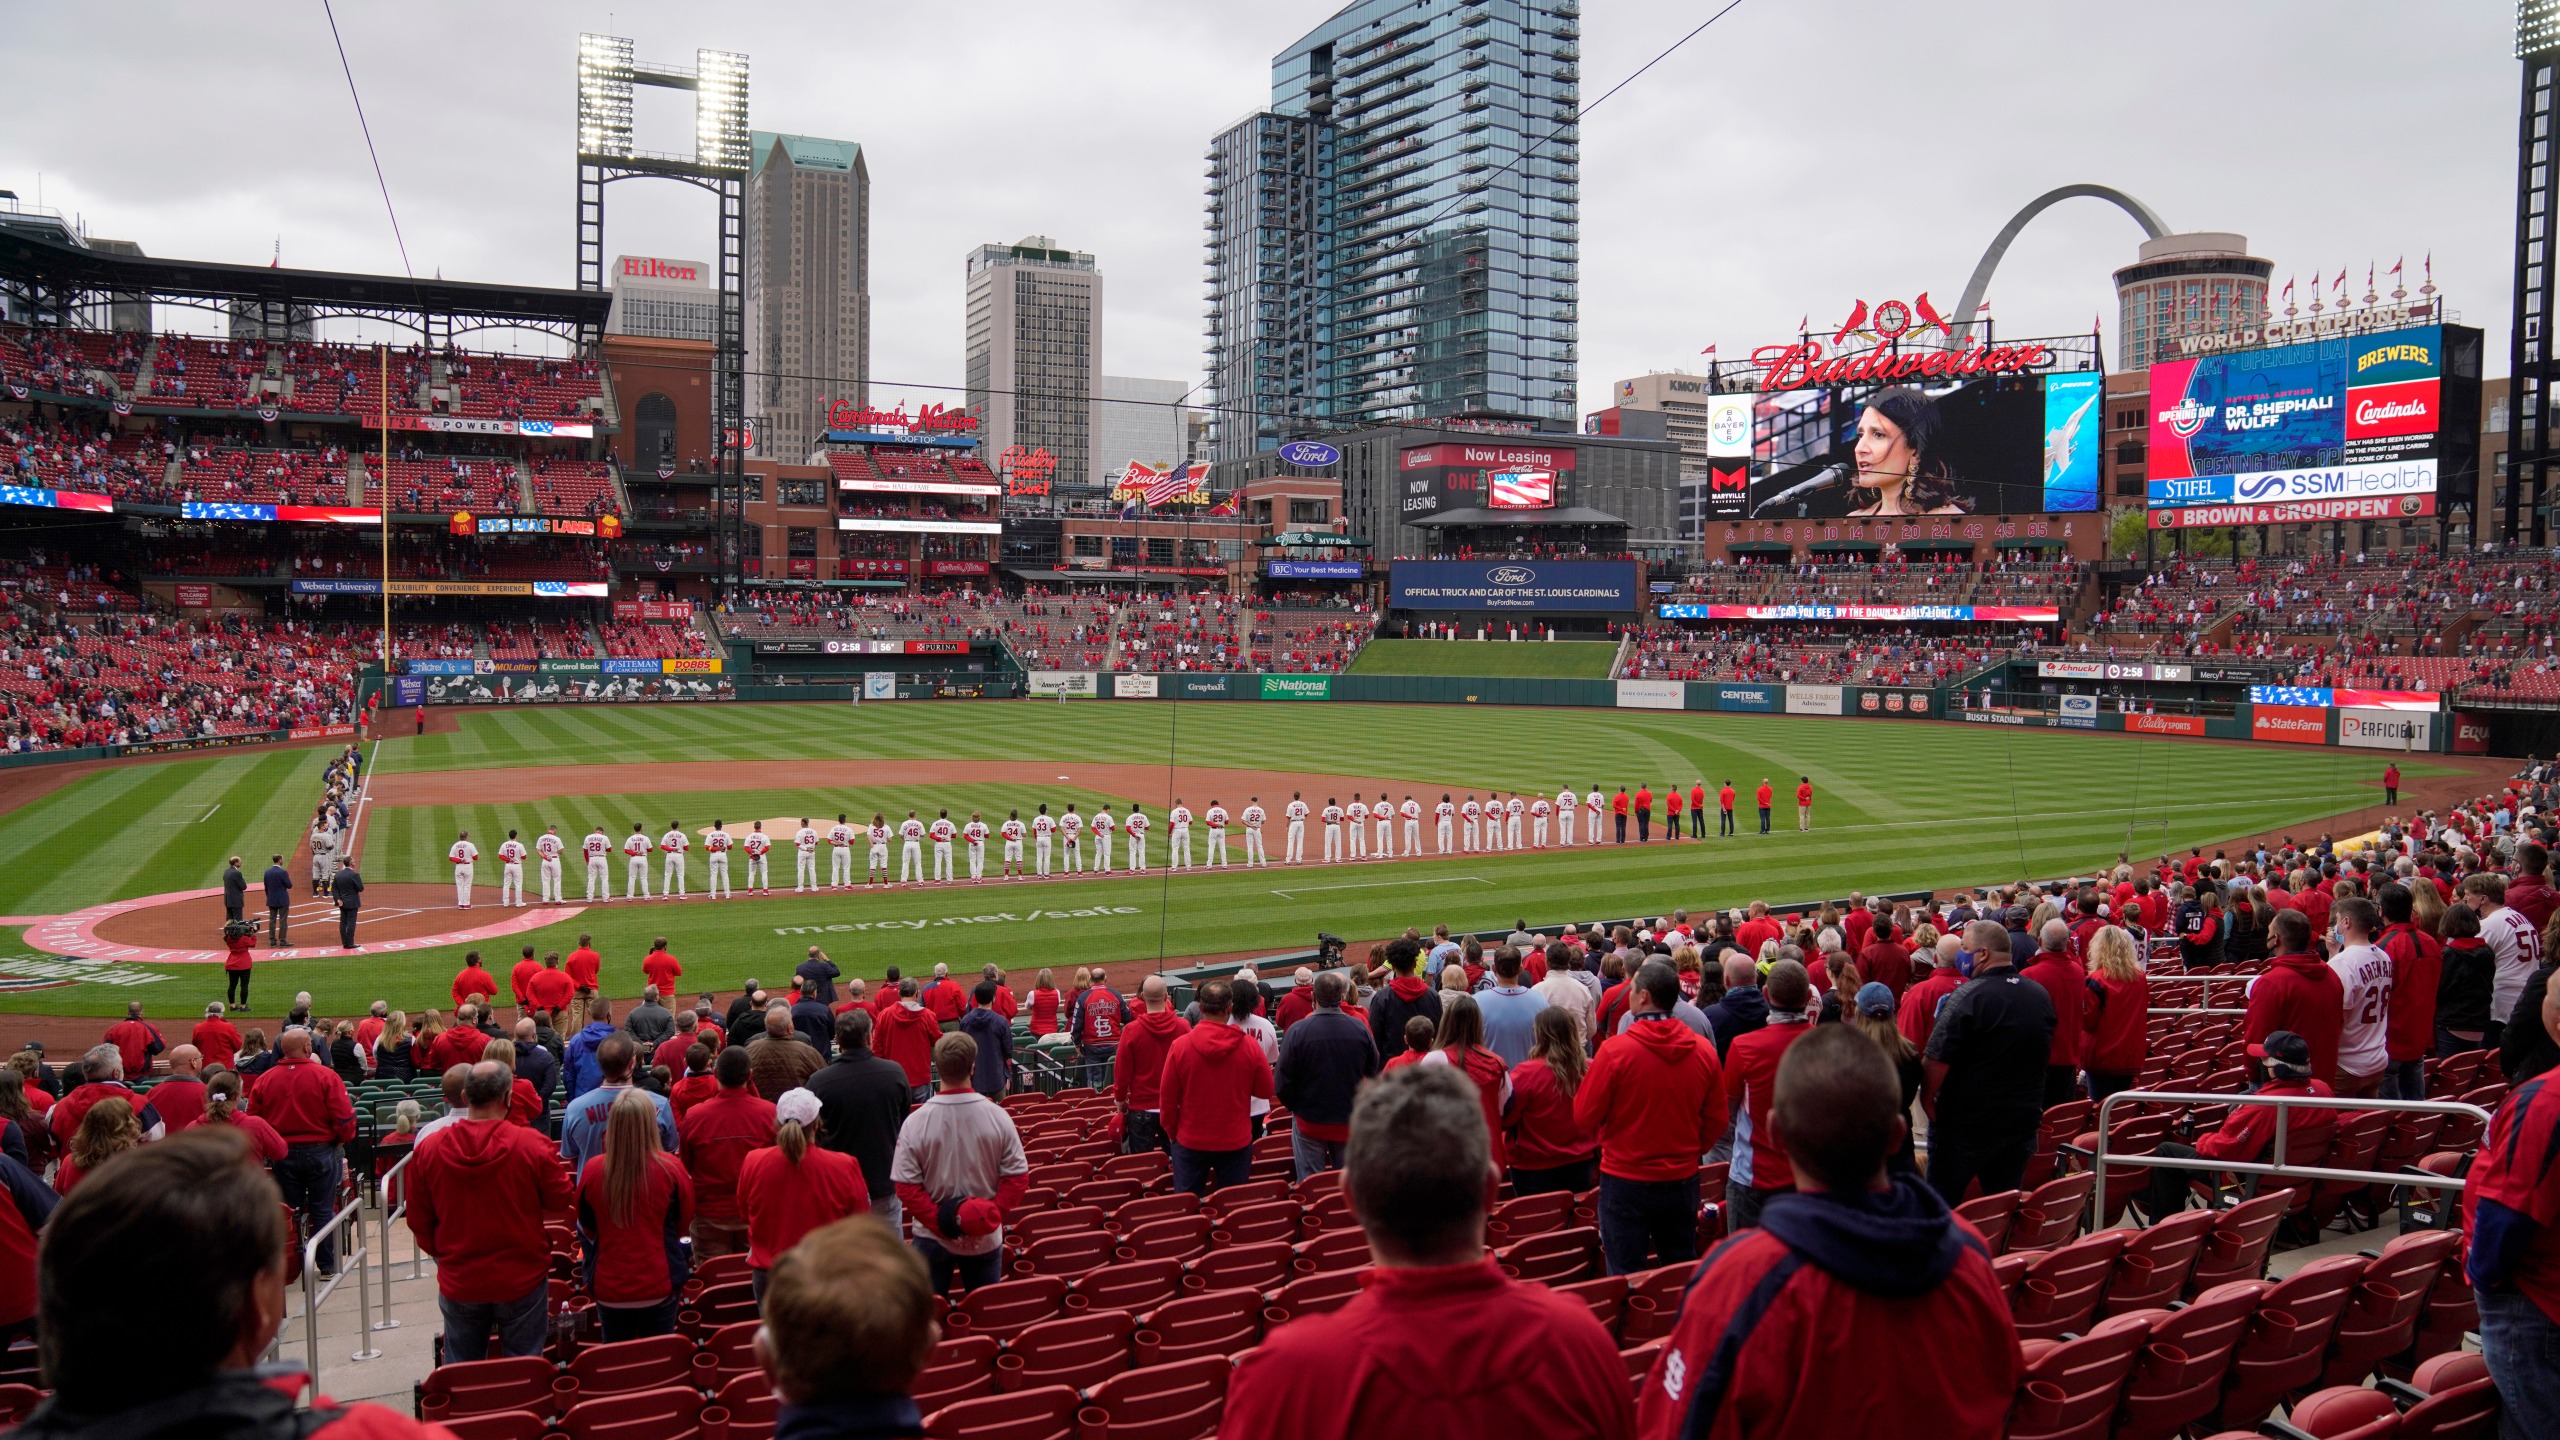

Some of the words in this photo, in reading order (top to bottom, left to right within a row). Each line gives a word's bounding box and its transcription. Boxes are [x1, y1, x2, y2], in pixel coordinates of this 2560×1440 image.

[623, 258, 697, 280] Hilton
[2179, 330, 2257, 354] WORLD
[2264, 307, 2411, 341] CHAMPIONS
[1751, 335, 2046, 391] Budweiser
[2242, 343, 2315, 371] OPENING
[2357, 344, 2428, 373] BREWERS
[1669, 380, 1701, 393] KMOV
[2225, 392, 2270, 403] NATIONAL
[2274, 389, 2313, 398] ANTHEM
[2159, 408, 2197, 423] OPENING
[2199, 406, 2216, 418] DAY
[2226, 406, 2250, 420] DR.
[2253, 396, 2333, 416] SHEPHALI
[2356, 399, 2427, 425] Cardinals
[829, 399, 909, 429] Cardinals
[908, 401, 978, 433] Nation
[365, 416, 406, 428] THT'S
[443, 420, 500, 431] POWER
[2226, 415, 2279, 431] WULFF
[895, 434, 936, 444] ROOFTOP
[2388, 435, 2403, 443] BEEN
[2404, 433, 2434, 441] WORKING
[1292, 444, 1328, 463] Ford
[2367, 445, 2387, 453] FRONT
[2406, 442, 2429, 450] CARING
[1000, 445, 1058, 473] Bally
[1407, 451, 1432, 467] Cardinals
[1465, 448, 1495, 462] Now
[1499, 449, 1552, 467] Leasing
[2195, 455, 2263, 477] OPENING
[2268, 450, 2299, 471] DAY
[1012, 469, 1044, 480] SPORTS
[1009, 480, 1049, 496] Live!
[1410, 480, 1430, 494] NOW
[2166, 480, 2216, 498] STIFEL
[1403, 496, 1437, 512] LEASING
[2183, 507, 2253, 526] BROWN
[2258, 509, 2268, 521] &
[2274, 499, 2389, 524] CROUPPEN
[478, 519, 509, 532] BIG
[512, 518, 550, 533] MAC
[553, 519, 595, 535] LAND
[1824, 526, 1838, 540] 10
[1849, 526, 1863, 540] 14
[1875, 525, 1890, 540] 17
[1902, 525, 1920, 539] 20
[1931, 524, 1951, 539] 24
[1963, 524, 1983, 538] 42
[1995, 523, 2015, 538] 45
[2028, 522, 2047, 537] 85
[1749, 527, 1754, 542] 1
[1764, 528, 1774, 542] 2
[1784, 527, 1793, 541] 6
[1804, 527, 1813, 541] 9
[1274, 565, 1290, 574] BJC
[1495, 568, 1527, 584] Ford
[300, 581, 333, 592] Webster
[335, 581, 377, 593] University
[389, 583, 429, 592] FLEXIBILITY
[435, 583, 481, 592] CONVENIENCE
[487, 584, 526, 593] EXPERIENCE
[1405, 588, 1441, 597] OFFICIAL
[1441, 588, 1468, 597] TRUCK
[1468, 588, 1487, 597] AND
[1487, 588, 1504, 597] CAR
[1505, 588, 1517, 597] OF
[1517, 588, 1534, 597] THE
[1534, 588, 1547, 597] ST.
[1547, 588, 1572, 597] LOUIS
[1573, 588, 1620, 597] CARDINALS
[1487, 599, 1535, 607] BuyFordNow.com
[669, 607, 689, 617] 009
[1781, 607, 1798, 618] CAN
[1799, 607, 1814, 618] YOU
[1836, 607, 1847, 618] BY
[1849, 607, 1864, 618] THE
[1866, 607, 1898, 618] DAWN'S
[1901, 608, 1925, 618] EARLY
[842, 643, 860, 652] 2:58
[880, 643, 895, 651] 56°
[925, 643, 957, 651] PURINA
[495, 662, 538, 672] MOLottery
[618, 660, 659, 668] SITEMAN
[675, 660, 711, 668] DOBBS
[2058, 664, 2100, 672] Schnucks
[865, 672, 894, 680] CarShield
[2122, 667, 2143, 677] 2:58
[2165, 668, 2181, 678] 56°
[2200, 671, 2220, 680] Mercy
[400, 679, 421, 688] Webster
[1279, 679, 1327, 691] National
[1721, 690, 1764, 700] CENTENE
[1965, 712, 1989, 722] BUSCH
[1991, 713, 2024, 724] STADIUM
[2137, 715, 2167, 732] Bally
[2168, 721, 2191, 730] SPORTS
[1178, 814, 1188, 823] 30
[1213, 814, 1223, 822] 29
[1250, 813, 1260, 822] 22
[873, 828, 884, 838] 53
[907, 827, 918, 837] 46
[937, 826, 948, 836] 40
[970, 828, 981, 838] 48
[1007, 827, 1019, 837] 34
[1036, 822, 1047, 831] 33
[589, 842, 601, 852] 28
[671, 838, 677, 848] 3
[712, 838, 724, 848] 26
[750, 840, 762, 850] 27
[804, 836, 815, 845] 63
[458, 849, 465, 858] 8
[506, 849, 515, 859] 19
[543, 843, 552, 852] 13
[773, 905, 1143, 936] mercy.net/safe
[2187, 917, 2201, 931] 10
[2515, 930, 2541, 963] 50
[2361, 984, 2391, 1024] 28
